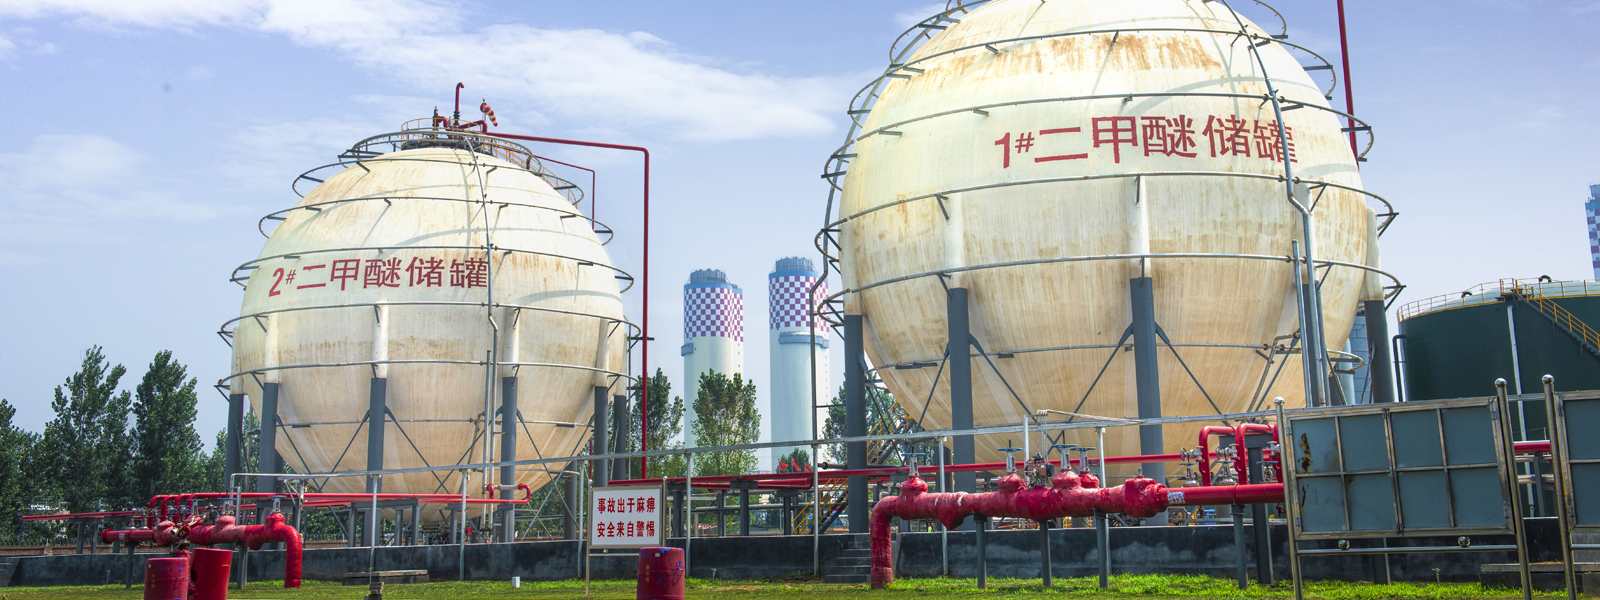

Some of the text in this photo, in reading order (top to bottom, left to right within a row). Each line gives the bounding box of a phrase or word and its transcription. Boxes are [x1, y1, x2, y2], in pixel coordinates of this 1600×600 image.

[994, 114, 1298, 168] 1#二甲醚储罐
[268, 256, 489, 297] 2#二甲醚储罐
[597, 496, 656, 514] 事故出于麻痹
[597, 520, 655, 538] 安全来自警惕
